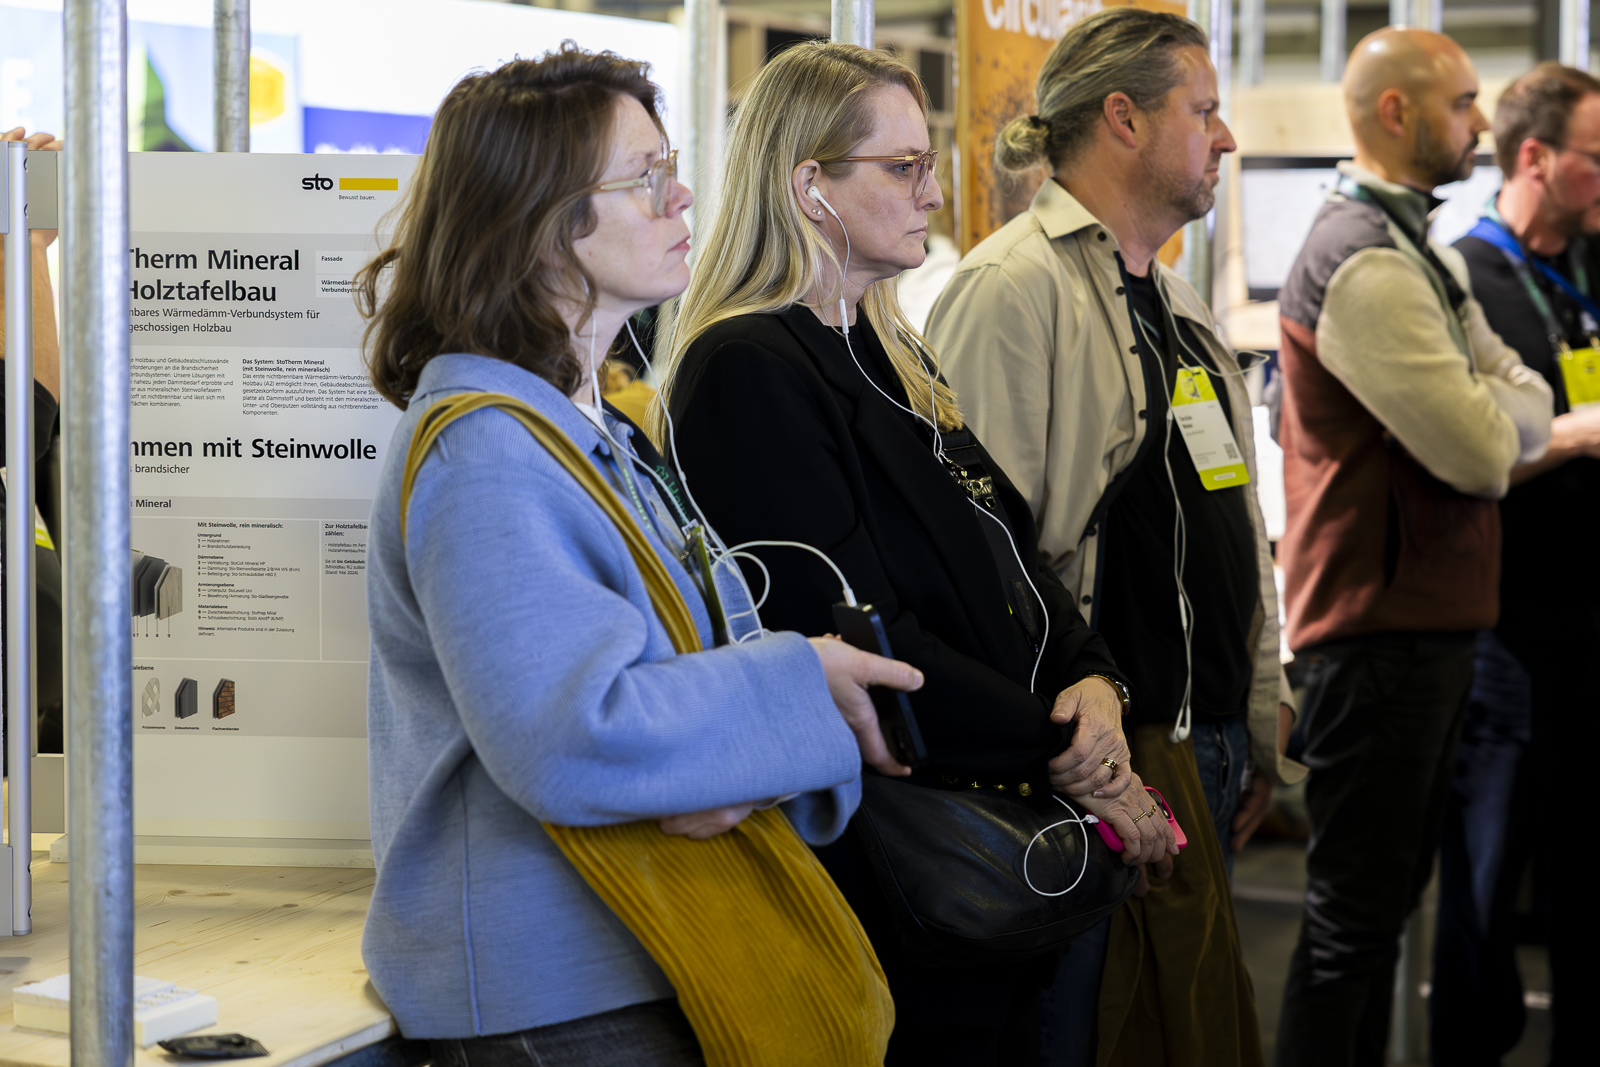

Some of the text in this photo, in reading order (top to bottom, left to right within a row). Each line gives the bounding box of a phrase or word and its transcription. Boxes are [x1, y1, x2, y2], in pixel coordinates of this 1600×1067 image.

[302, 173, 334, 190] sto
[129, 248, 300, 270] herm Mineral
[162, 308, 303, 320] Wärmedämm-Verbundsystem
[306, 309, 320, 319] für
[129, 323, 232, 334] geschossigen Holzbau
[202, 437, 242, 457] mit
[251, 438, 377, 460] Steinwolle
[135, 464, 190, 474] brandsicher
